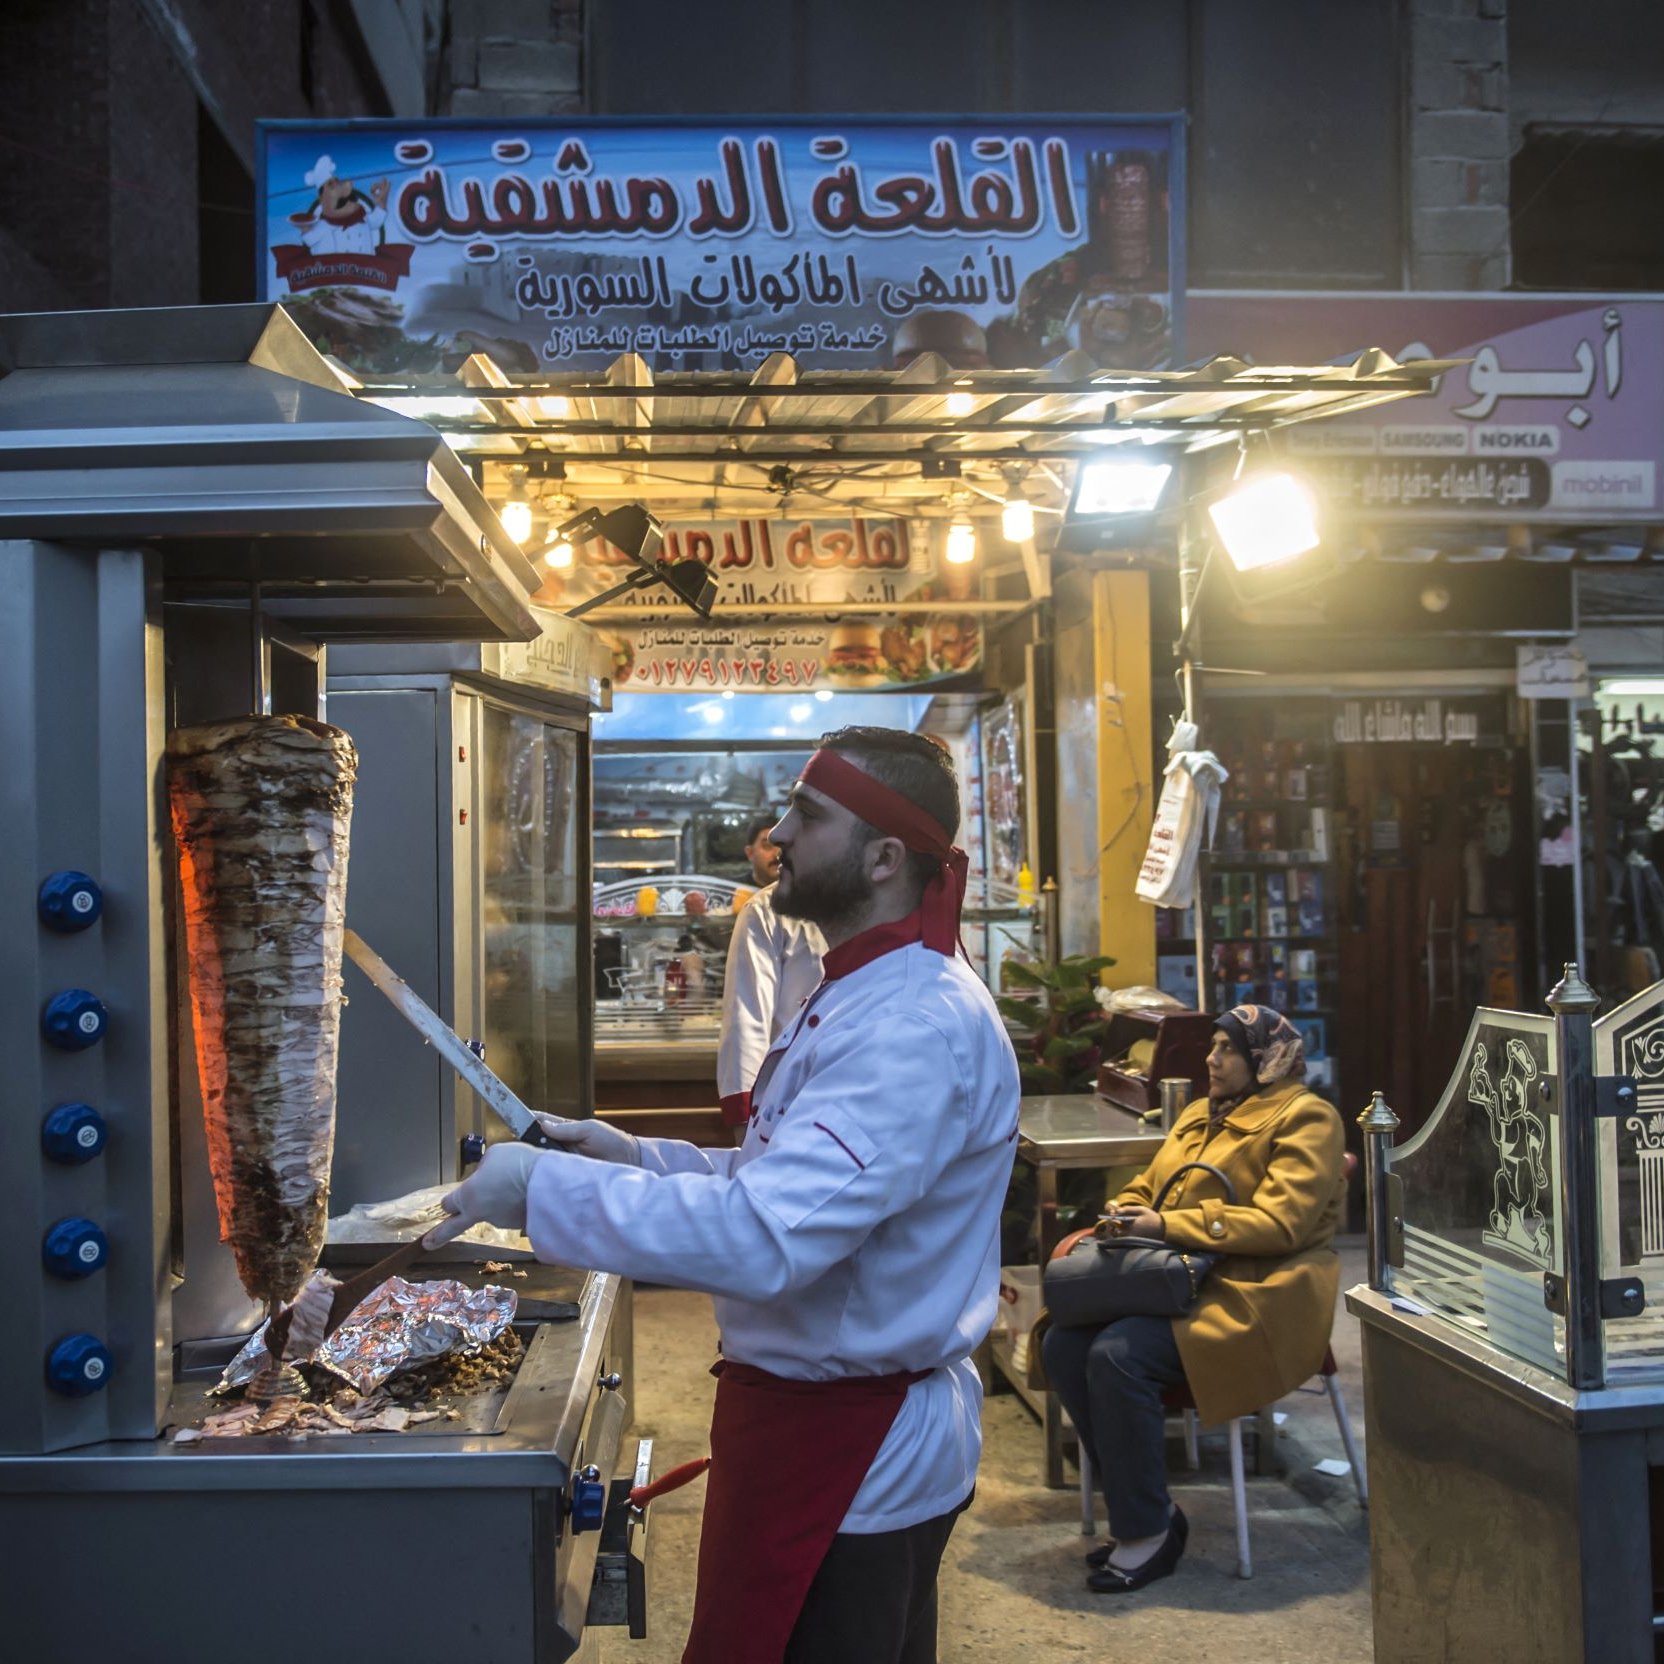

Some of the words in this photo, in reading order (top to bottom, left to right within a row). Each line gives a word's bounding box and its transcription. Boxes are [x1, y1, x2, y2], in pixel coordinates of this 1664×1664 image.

[397, 137, 794, 263] الدمشقية
[811, 137, 1081, 238] القلعة
[516, 254, 673, 320] السورية
[690, 250, 862, 314] المأكولات
[879, 244, 1017, 317] لأشهى
[543, 326, 633, 361] للمنازل
[635, 326, 732, 360] الطلبات
[734, 324, 817, 359] توصيل
[820, 322, 887, 351] خدمة
[1450, 307, 1622, 424] أبو
[1480, 432, 1554, 448] NOKIA
[1563, 474, 1643, 495] mobinil
[637, 630, 686, 650] للمنازل
[688, 630, 741, 650] الطلبات
[743, 629, 788, 650] توصيل
[790, 629, 826, 648] خدمة
